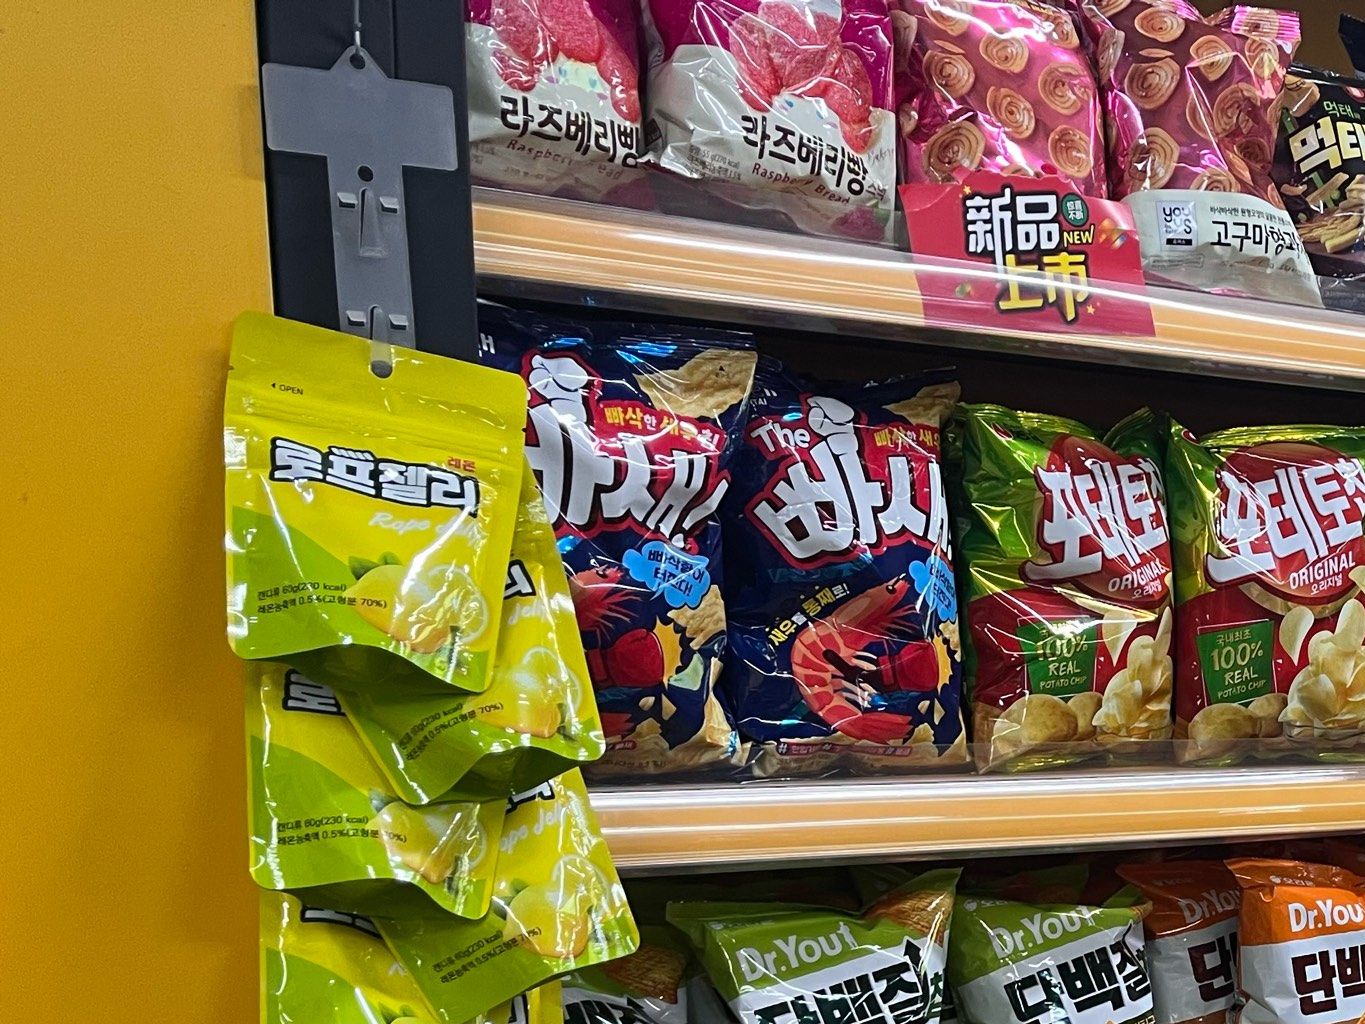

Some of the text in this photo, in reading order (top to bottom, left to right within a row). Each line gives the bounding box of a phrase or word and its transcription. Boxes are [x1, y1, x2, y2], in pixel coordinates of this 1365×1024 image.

[741, 115, 868, 196] 라즈베리빵
[814, 184, 851, 204] Bread
[966, 186, 1061, 270] 新品
[1063, 225, 1094, 247] NEW
[998, 253, 1089, 322] 上市
[279, 384, 304, 396] OPEN
[750, 420, 812, 454] The
[447, 455, 476, 473] 레몬
[1108, 560, 1166, 593] ORIGINAL
[1288, 555, 1357, 591] ORIGINAL
[1132, 579, 1165, 600] 오리지널
[1309, 574, 1344, 596] 오리지널
[360, 597, 388, 609] 70%)
[1210, 640, 1264, 671] 100%
[1047, 661, 1082, 677] REAL
[1223, 666, 1260, 686] REAL
